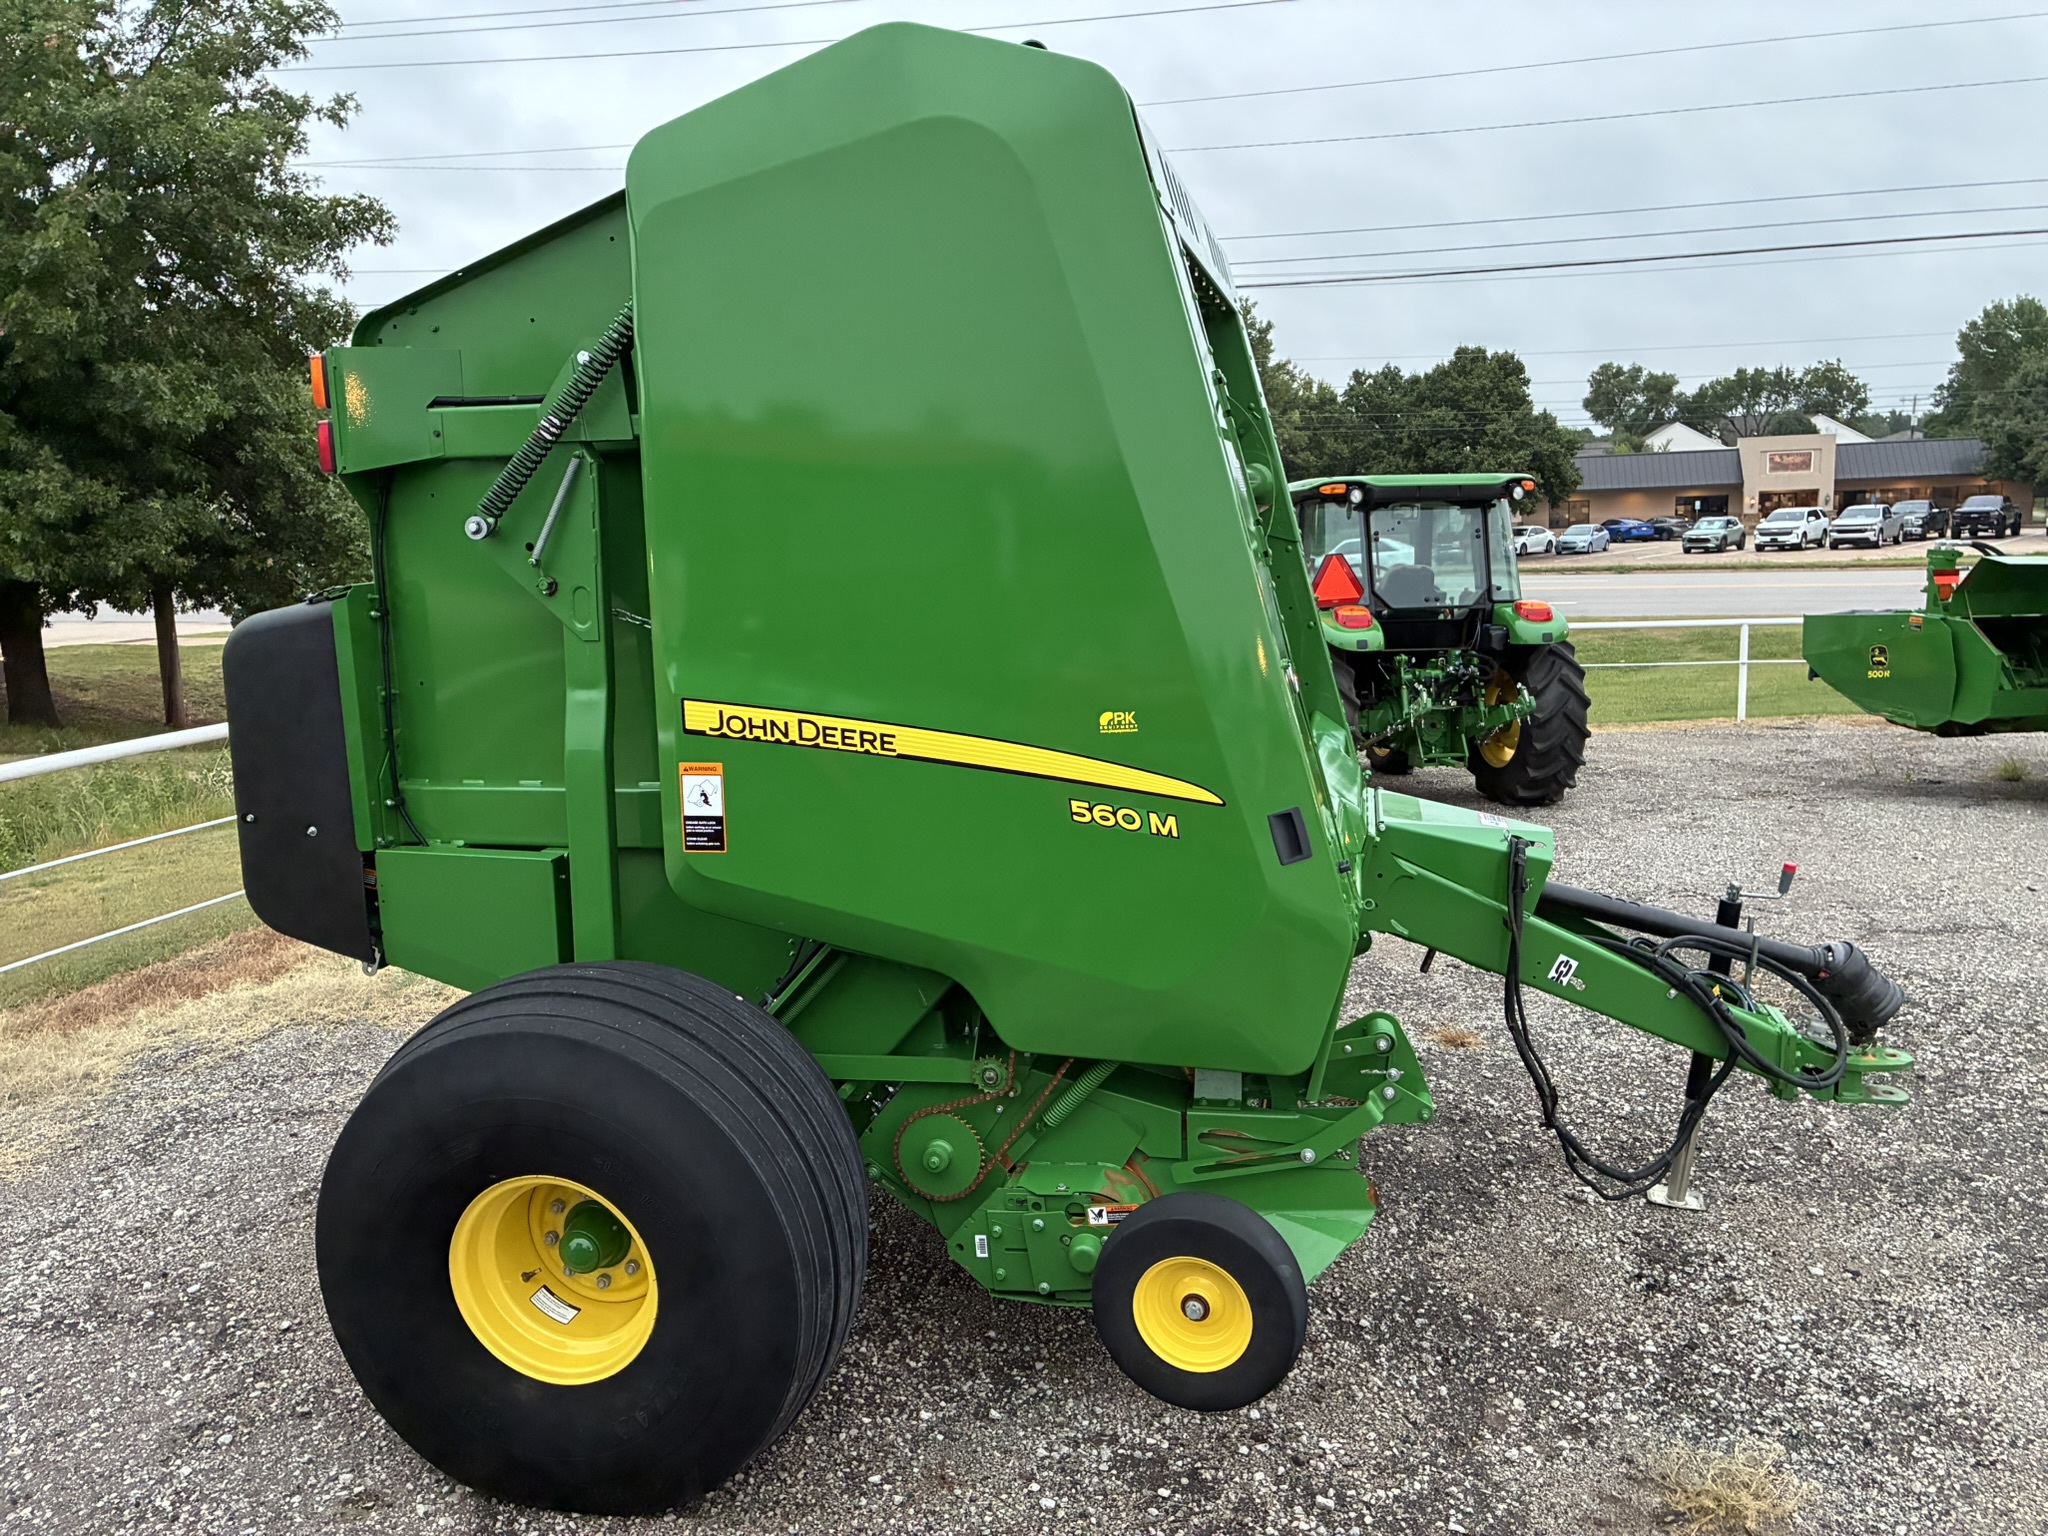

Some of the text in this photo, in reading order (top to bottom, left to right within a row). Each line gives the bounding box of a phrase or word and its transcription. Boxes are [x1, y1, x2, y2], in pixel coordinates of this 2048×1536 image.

[709, 710, 897, 753] JOHN DEERE
[1069, 799, 1180, 839] 560 M
